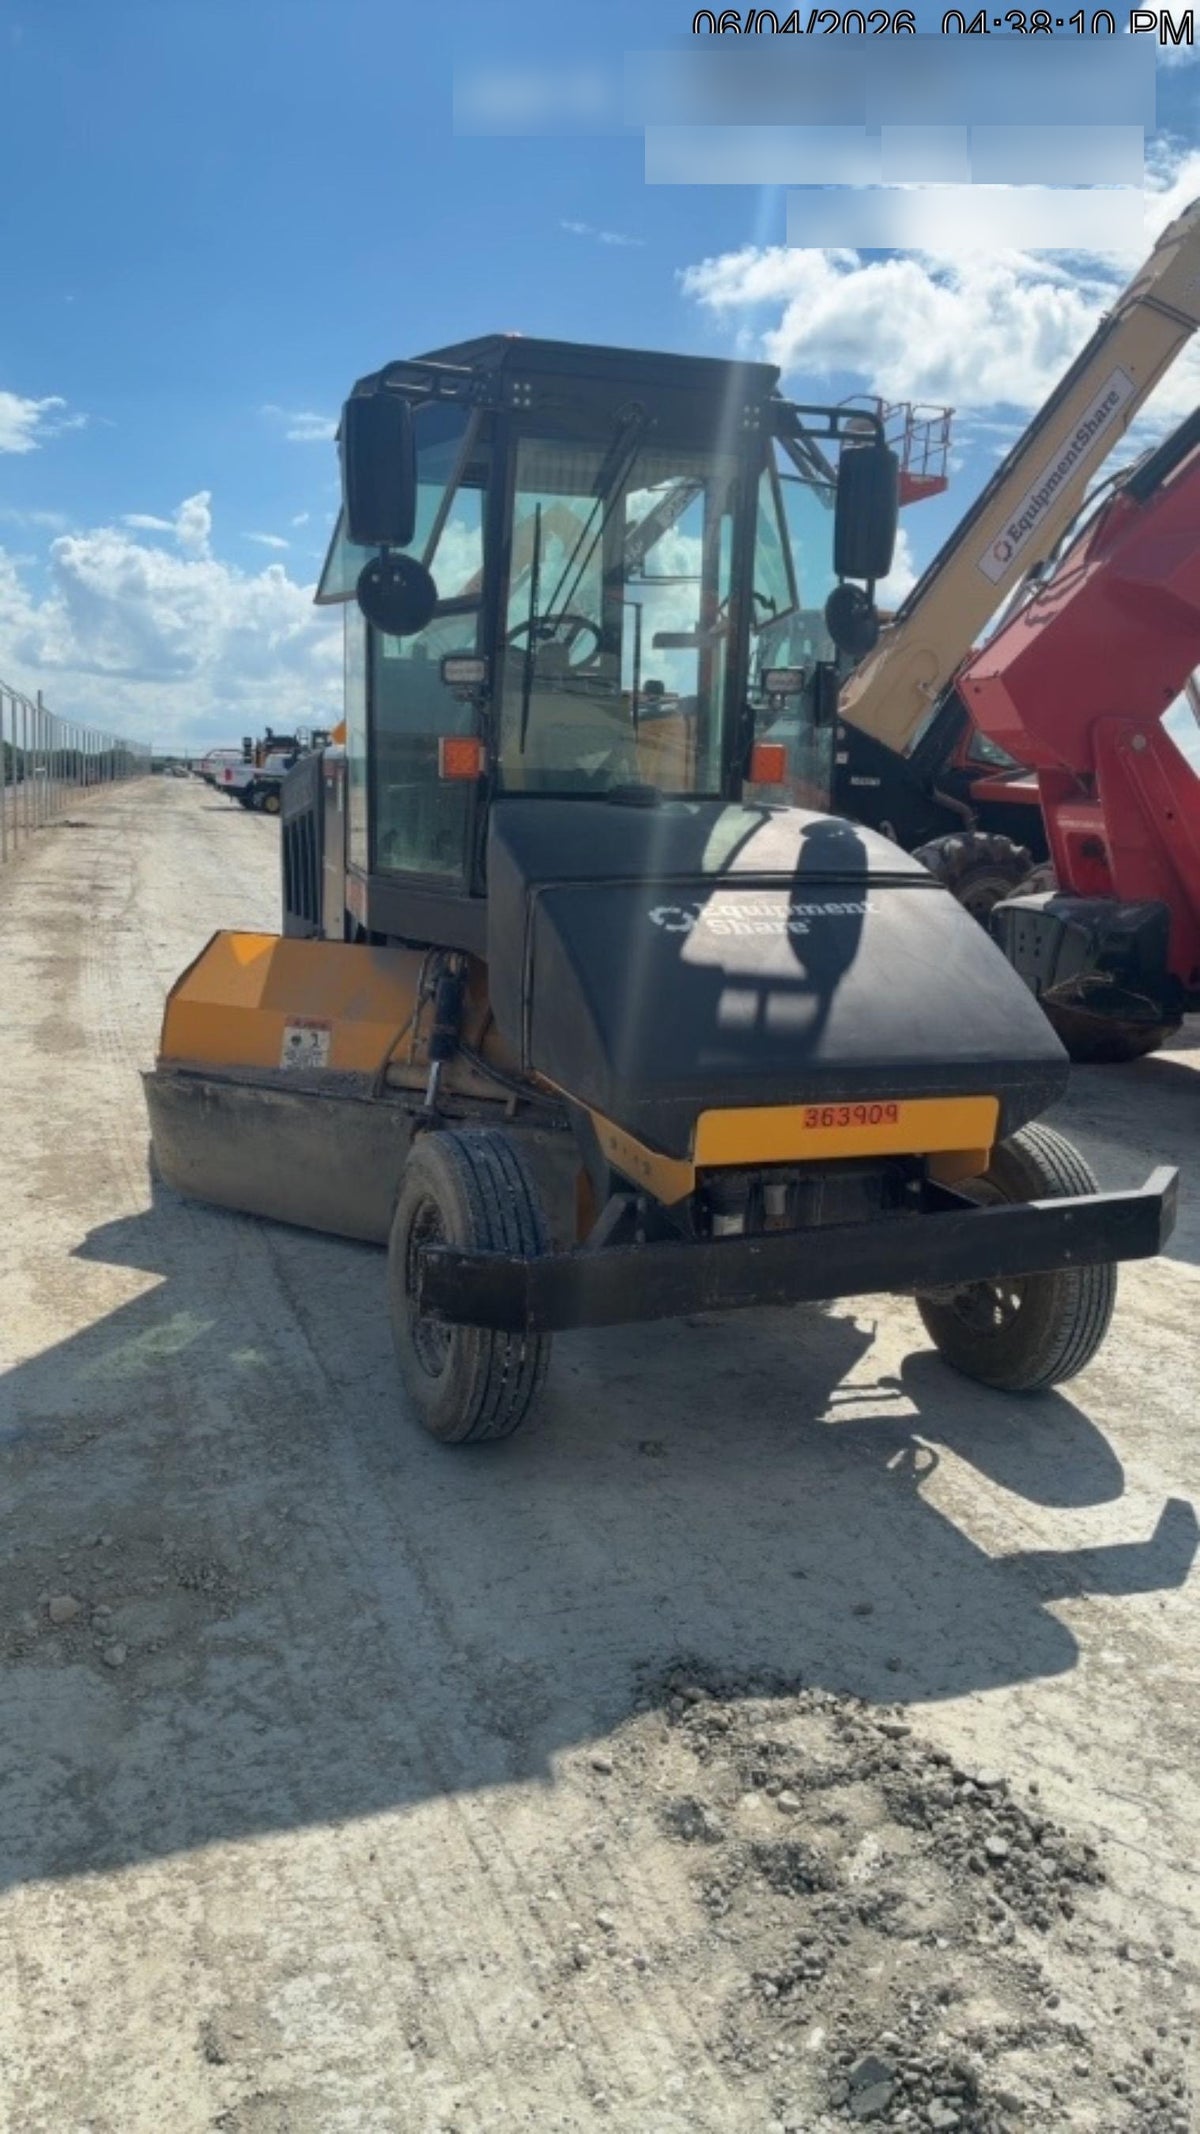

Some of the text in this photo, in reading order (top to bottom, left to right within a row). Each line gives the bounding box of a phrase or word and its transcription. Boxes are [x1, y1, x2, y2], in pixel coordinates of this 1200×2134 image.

[1008, 390, 1119, 544] EquipmentShare
[693, 901, 881, 918] Equipment
[707, 919, 810, 936] Share
[805, 1104, 898, 1129] 363909
